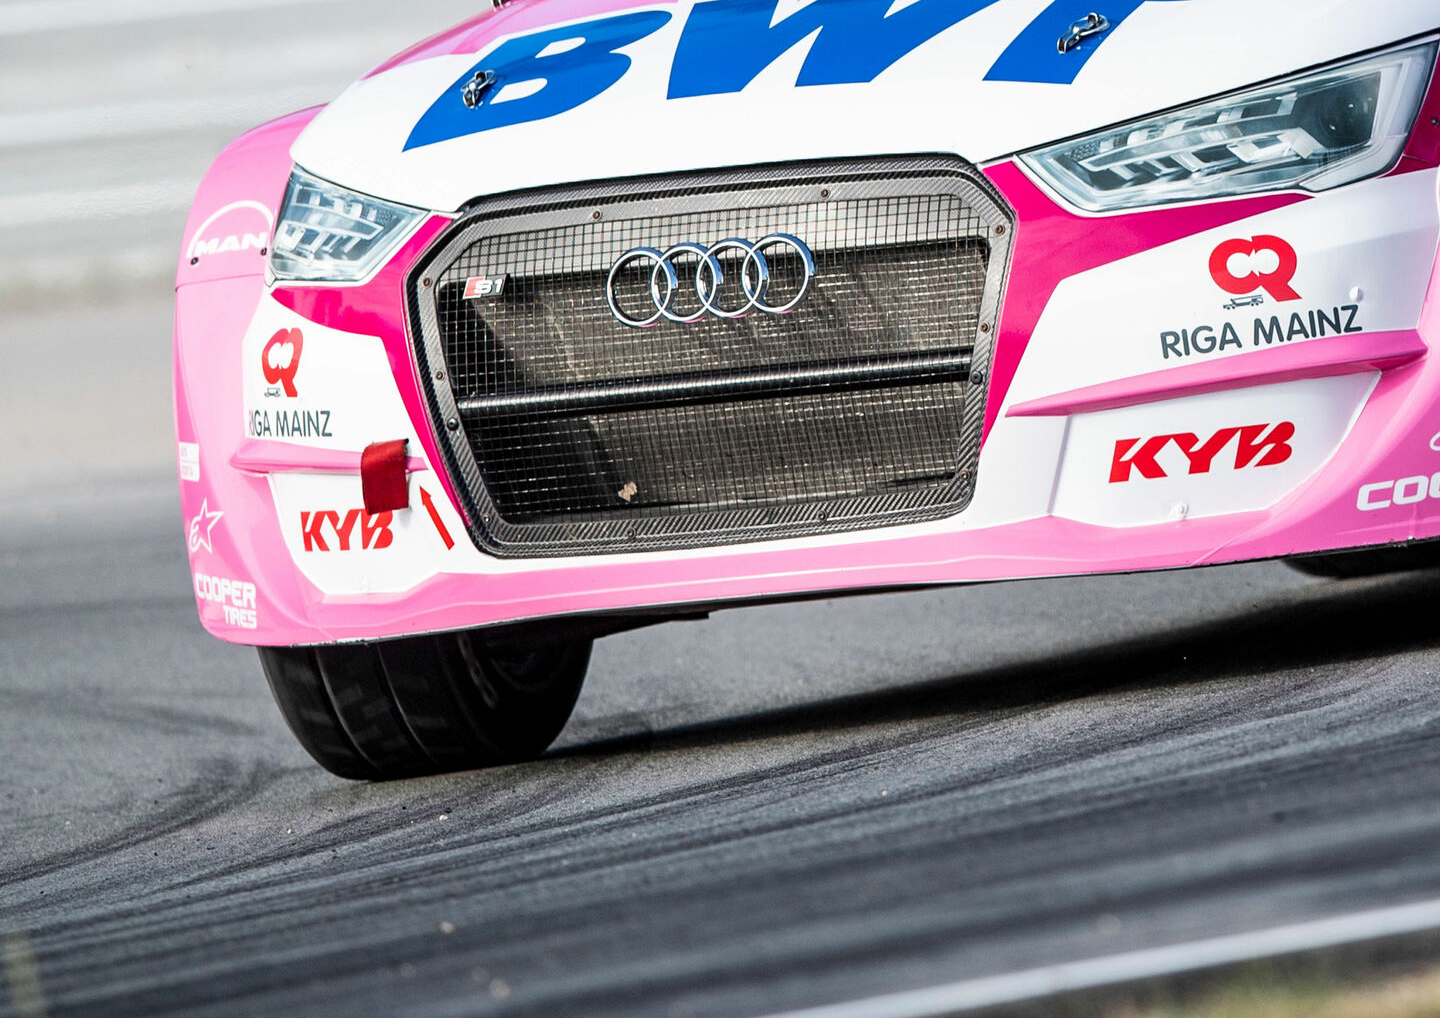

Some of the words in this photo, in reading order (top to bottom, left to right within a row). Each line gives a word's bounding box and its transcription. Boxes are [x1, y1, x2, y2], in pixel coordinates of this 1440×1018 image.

[194, 232, 268, 256] MAN
[1160, 322, 1243, 359] RIGA
[1253, 304, 1363, 346] MAINZ
[276, 409, 333, 437] MAINZ
[1108, 420, 1296, 483] KYB
[300, 508, 394, 552] KYB
[195, 572, 256, 610] COOPER
[223, 605, 257, 630] TIRES
